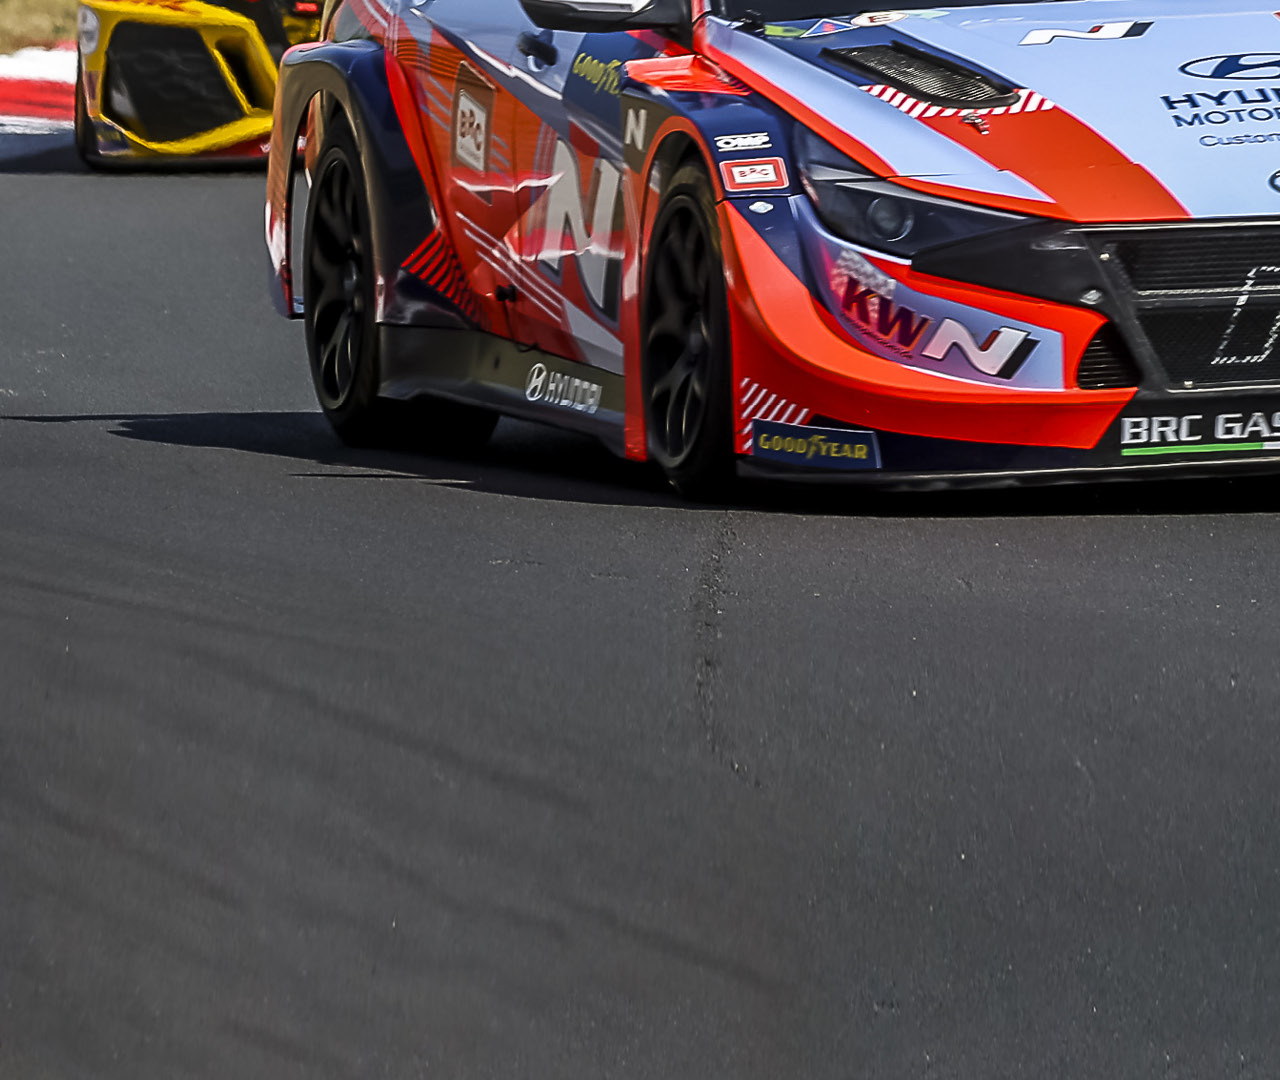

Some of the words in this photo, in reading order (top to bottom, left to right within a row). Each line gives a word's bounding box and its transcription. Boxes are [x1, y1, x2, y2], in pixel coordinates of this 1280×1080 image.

[841, 274, 936, 352] KW
[1120, 414, 1203, 445] BRC
[758, 433, 869, 460] GOODYEAR
